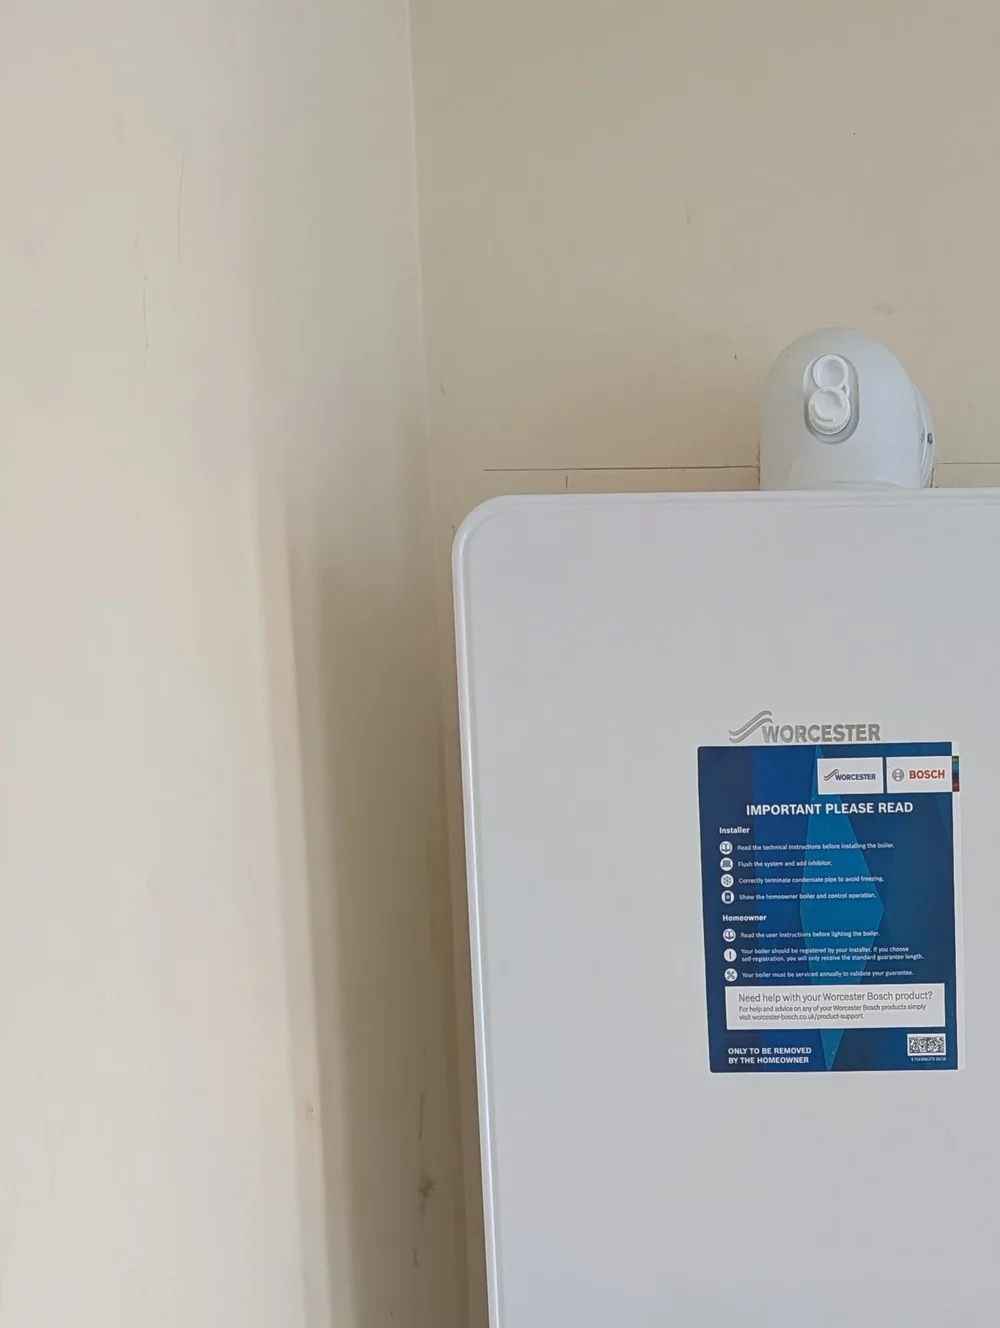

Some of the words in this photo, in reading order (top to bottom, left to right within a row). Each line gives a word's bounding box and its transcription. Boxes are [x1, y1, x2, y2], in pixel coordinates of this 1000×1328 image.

[761, 724, 881, 743] WORCESTER
[835, 773, 876, 781] WORCESTER
[909, 770, 945, 779] BOSCH
[746, 804, 822, 816] IMPORTANT
[825, 803, 875, 814] PLEASE
[878, 802, 913, 813] READ
[719, 826, 750, 834] Installer
[738, 993, 760, 1002] Need
[763, 993, 781, 1003] help
[782, 993, 801, 1002] with
[802, 994, 821, 1003] your
[822, 992, 866, 1001] Worcester
[867, 991, 893, 1001] Bosch
[895, 990, 933, 1001] product?
[749, 1005, 762, 1013] help
[881, 1003, 907, 1011] products
[728, 1047, 748, 1055] ONLY
[757, 1056, 809, 1064] HOMEOWNER
